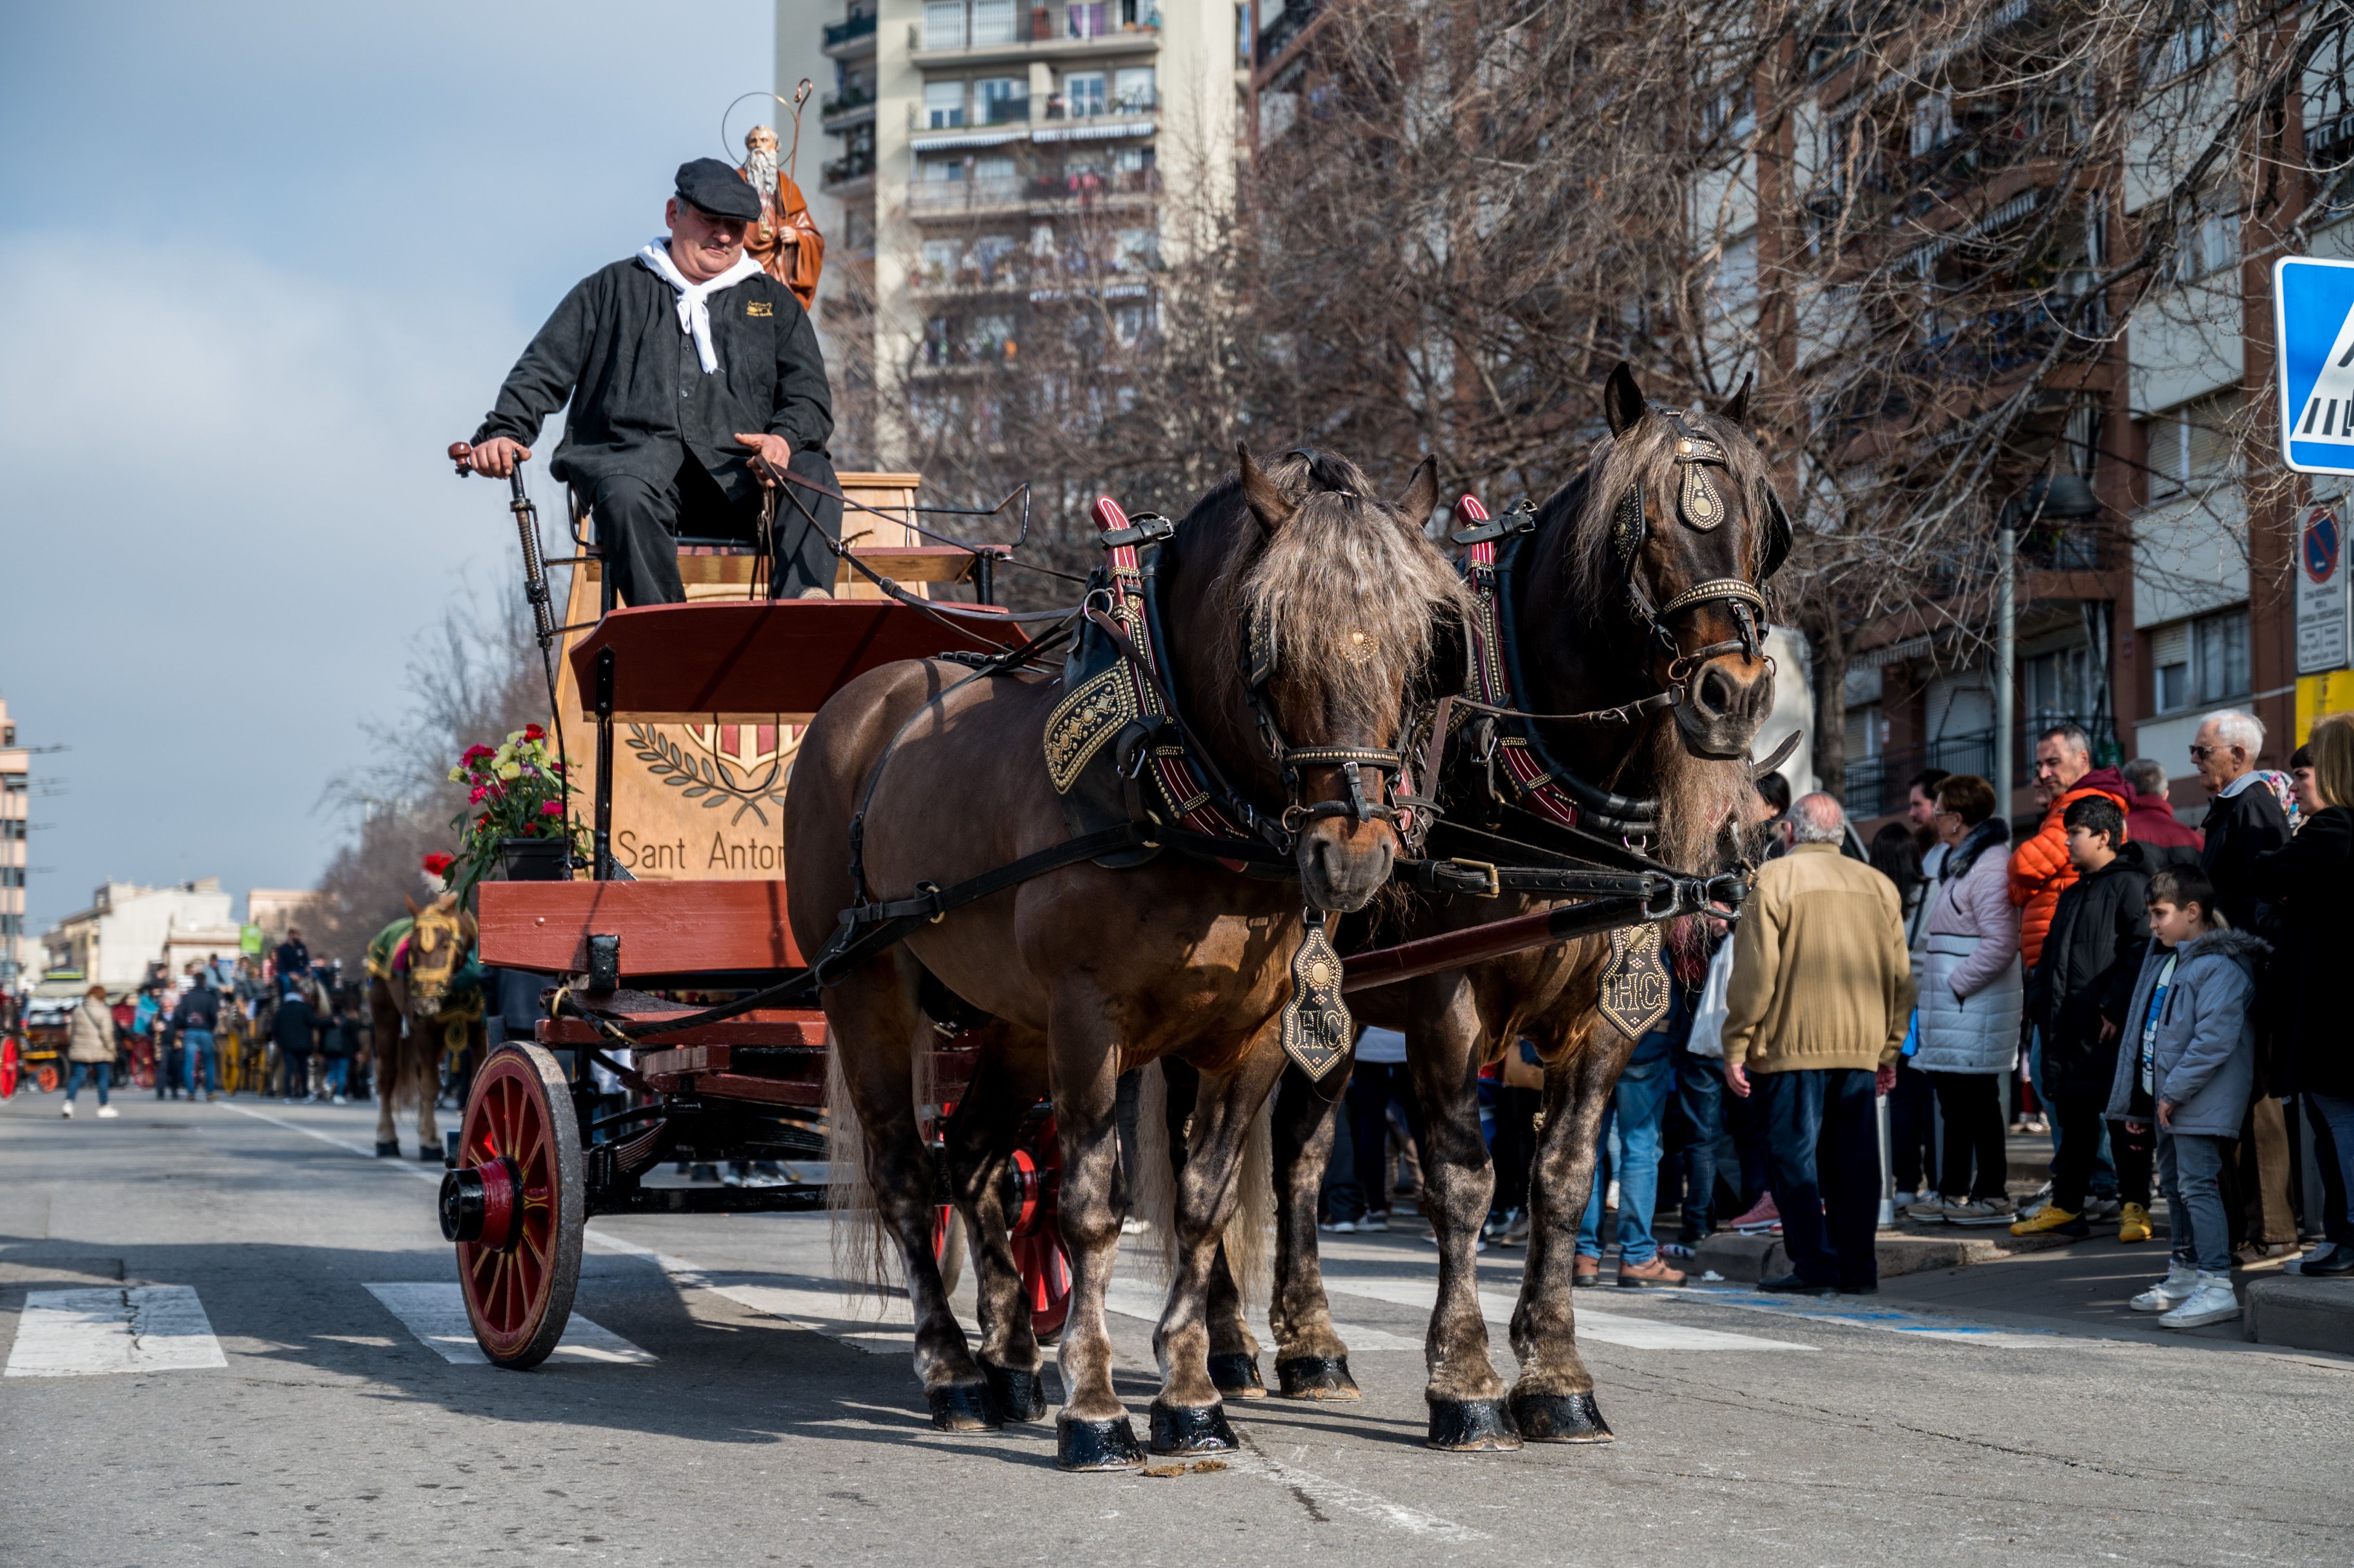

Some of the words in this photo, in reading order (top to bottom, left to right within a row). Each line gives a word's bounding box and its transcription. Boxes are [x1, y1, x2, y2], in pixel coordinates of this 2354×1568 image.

[618, 830, 685, 869] Sant
[1612, 972, 1662, 1011] HC
[1296, 1010, 1344, 1050] HC
